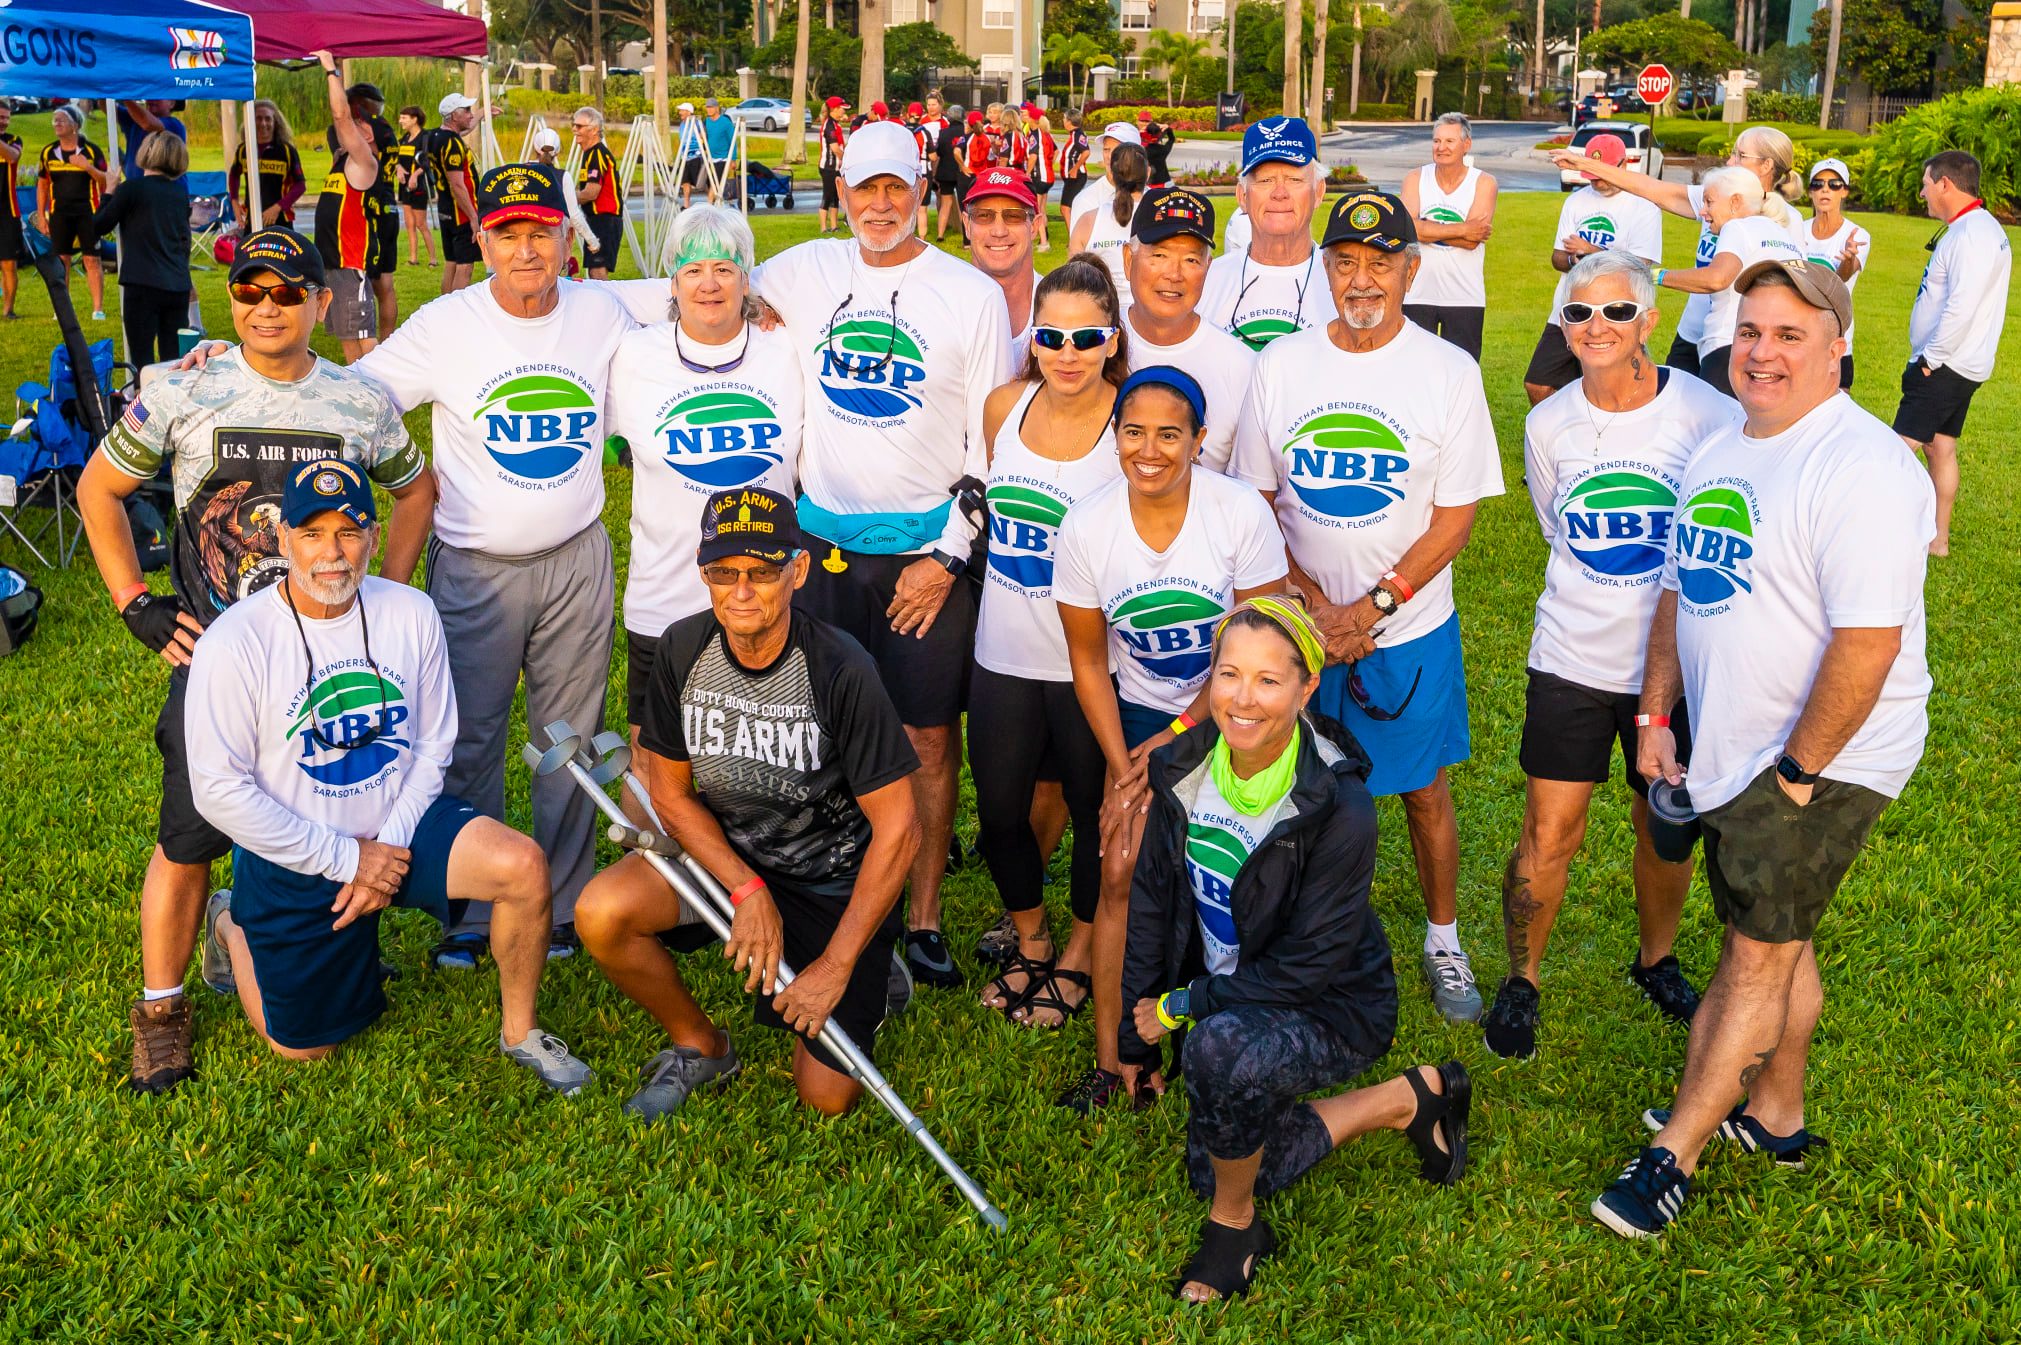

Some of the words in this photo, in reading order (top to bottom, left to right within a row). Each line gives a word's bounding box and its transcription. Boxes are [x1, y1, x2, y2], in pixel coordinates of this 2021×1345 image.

[0, 24, 97, 69] GONS
[175, 76, 203, 88] Tampa,
[204, 77, 214, 87] FL
[1639, 77, 1670, 92] STOP
[1259, 141, 1272, 151] AIR
[1275, 140, 1304, 148] FORCE
[485, 178, 498, 193] U.S.
[495, 167, 527, 180] MARINE
[527, 169, 552, 188] CORPS
[499, 193, 539, 205] VETERAN
[249, 250, 287, 261] VETERAN
[819, 312, 854, 336] NAHAN
[910, 328, 930, 352] PARK
[1249, 308, 1306, 325] BENDERSON
[476, 369, 512, 401] NATHAN
[515, 363, 576, 379] BENDERSON
[577, 375, 596, 396] PARK
[820, 349, 926, 390] NBP
[656, 389, 690, 418] NATHAN
[693, 381, 754, 393] BENDERSON
[756, 389, 779, 409] PARK
[485, 411, 597, 443] NBP
[827, 405, 871, 428] SARASOTA,
[872, 418, 907, 429] FLORIDA
[1287, 405, 1324, 434] NATHAN
[1327, 401, 1388, 420] BENDERSON
[1388, 417, 1411, 442] PARK
[116, 434, 140, 459] MSGT
[222, 444, 250, 459] U.S.
[256, 445, 285, 461] AIR
[291, 446, 337, 463] FORCE
[665, 422, 782, 456] NBP
[497, 471, 546, 492] SARASOTA,
[547, 467, 580, 490] FLORIDA
[1291, 447, 1410, 483] NBP
[1561, 468, 1590, 500] NATHAN
[1594, 460, 1659, 476] BENDERSON
[1660, 473, 1680, 494] PAR
[683, 481, 716, 497] SARAS
[715, 496, 737, 514] U.S.
[740, 490, 778, 513] ARMY
[1008, 475, 1075, 505] BENDERSON
[1716, 476, 1752, 499] BENDERSON
[1749, 497, 1763, 526] PARK
[717, 522, 732, 534] 1SG
[733, 521, 774, 534] RETIRED
[1298, 505, 1345, 530] SARASOTA,
[1347, 512, 1388, 529] FLORIDA
[989, 512, 1058, 556] NB
[1676, 523, 1753, 570] NBP
[1581, 568, 1622, 588] SARASOTA,
[1104, 587, 1133, 616] NATHAN
[1136, 576, 1198, 592] BENDERSON
[1201, 584, 1225, 602] PARK
[1697, 603, 1731, 618] FLORIDA
[286, 674, 318, 718] NATHN
[382, 666, 407, 689] PARK
[693, 688, 721, 706] DUTY
[724, 694, 759, 715] HONOR
[300, 705, 409, 759] NBP
[683, 704, 729, 756] U.S.
[732, 714, 821, 772] ARMY
[313, 785, 363, 799] SARASOTA,
[364, 765, 399, 792] FLORIDA
[719, 765, 810, 802] STATES
